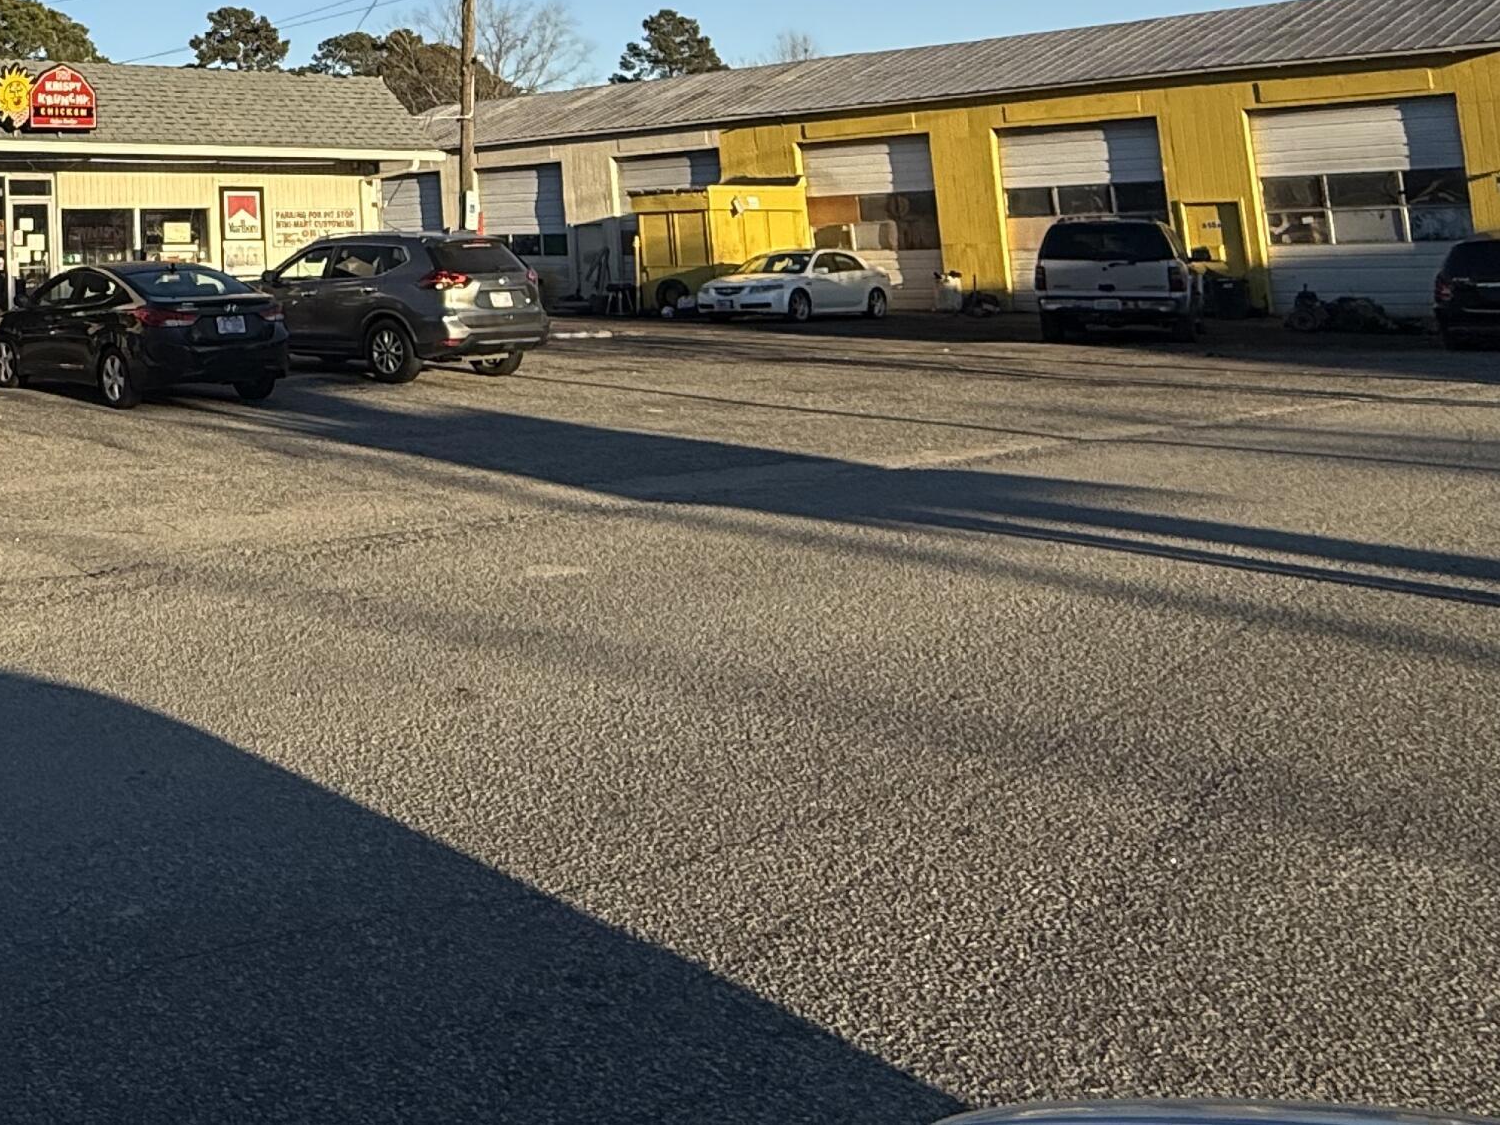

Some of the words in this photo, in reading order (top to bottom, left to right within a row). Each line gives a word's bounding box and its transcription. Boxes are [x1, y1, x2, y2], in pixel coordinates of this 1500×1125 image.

[45, 81, 82, 92] KRISPY
[40, 107, 88, 117] CHICKEN
[308, 210, 322, 219] FOR
[336, 210, 355, 219] STOP
